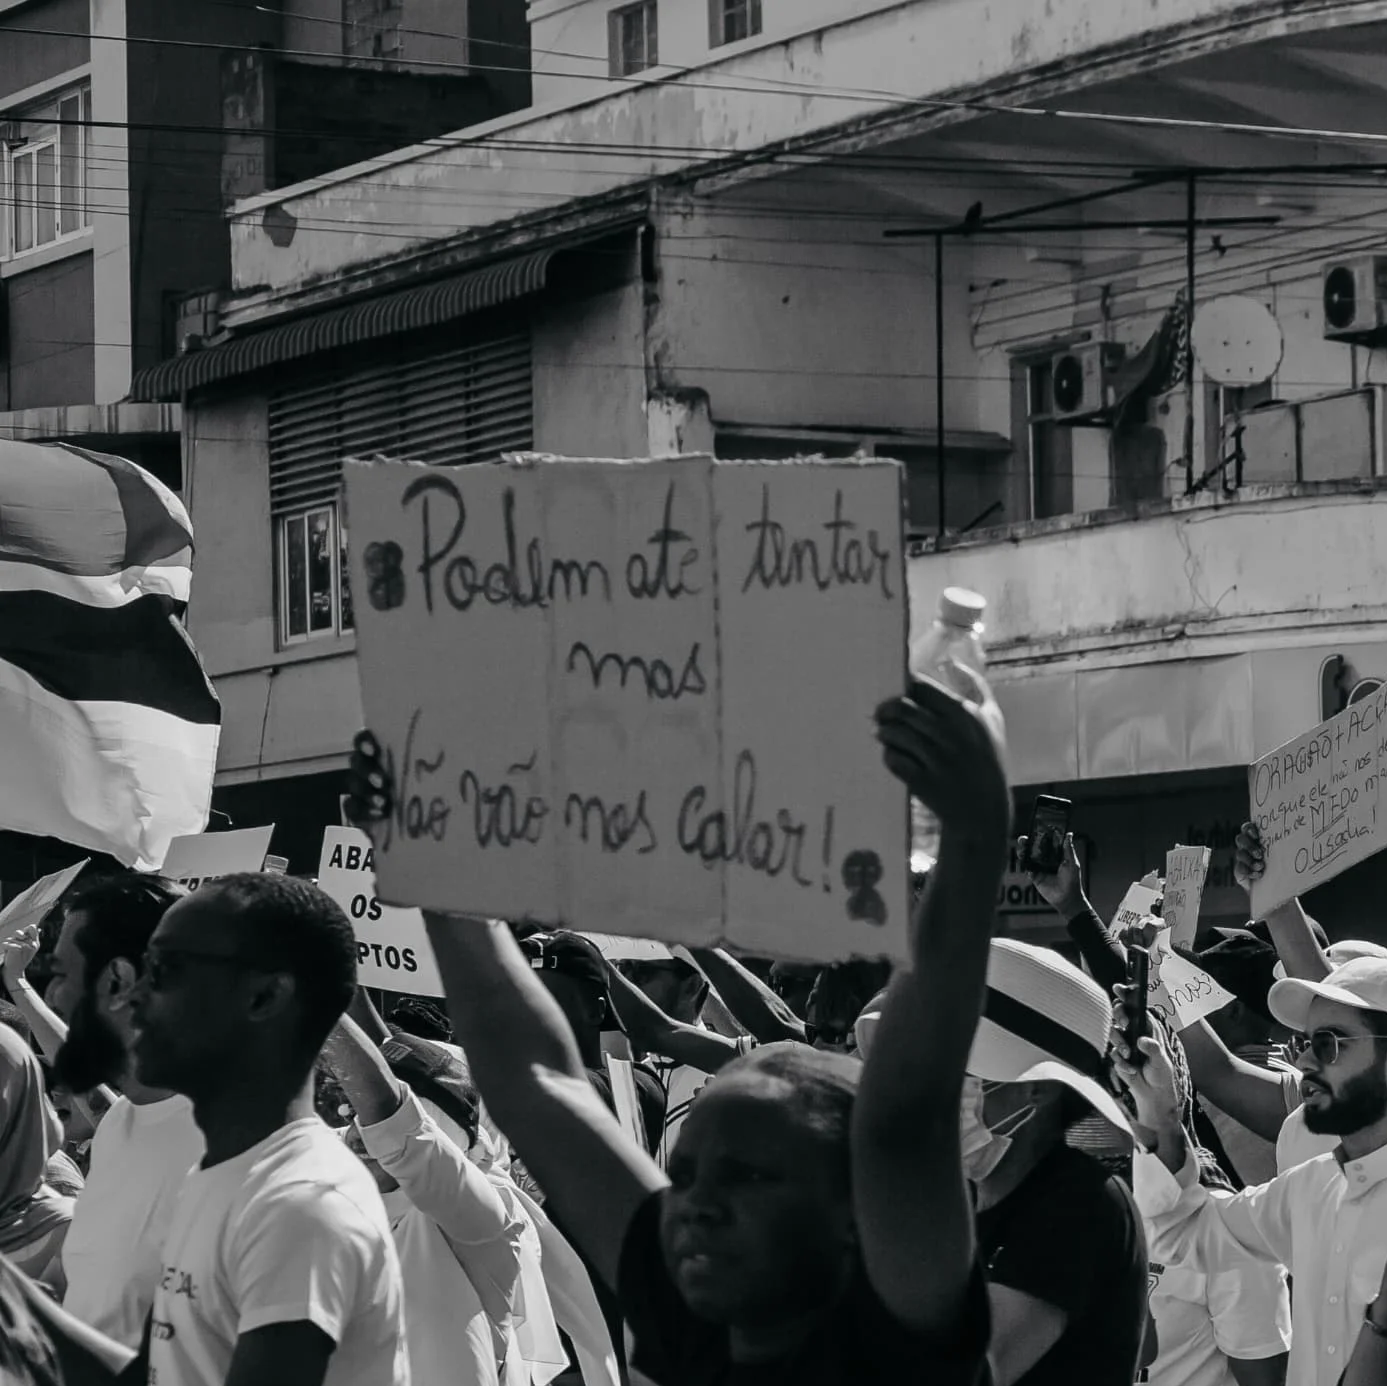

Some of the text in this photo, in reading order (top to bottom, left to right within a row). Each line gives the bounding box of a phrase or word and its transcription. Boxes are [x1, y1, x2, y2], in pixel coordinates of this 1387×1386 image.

[402, 474, 612, 615] Podem
[565, 789, 657, 854] nos
[329, 844, 374, 872] ABA
[351, 894, 383, 921] OS
[357, 941, 418, 972] PTOS
